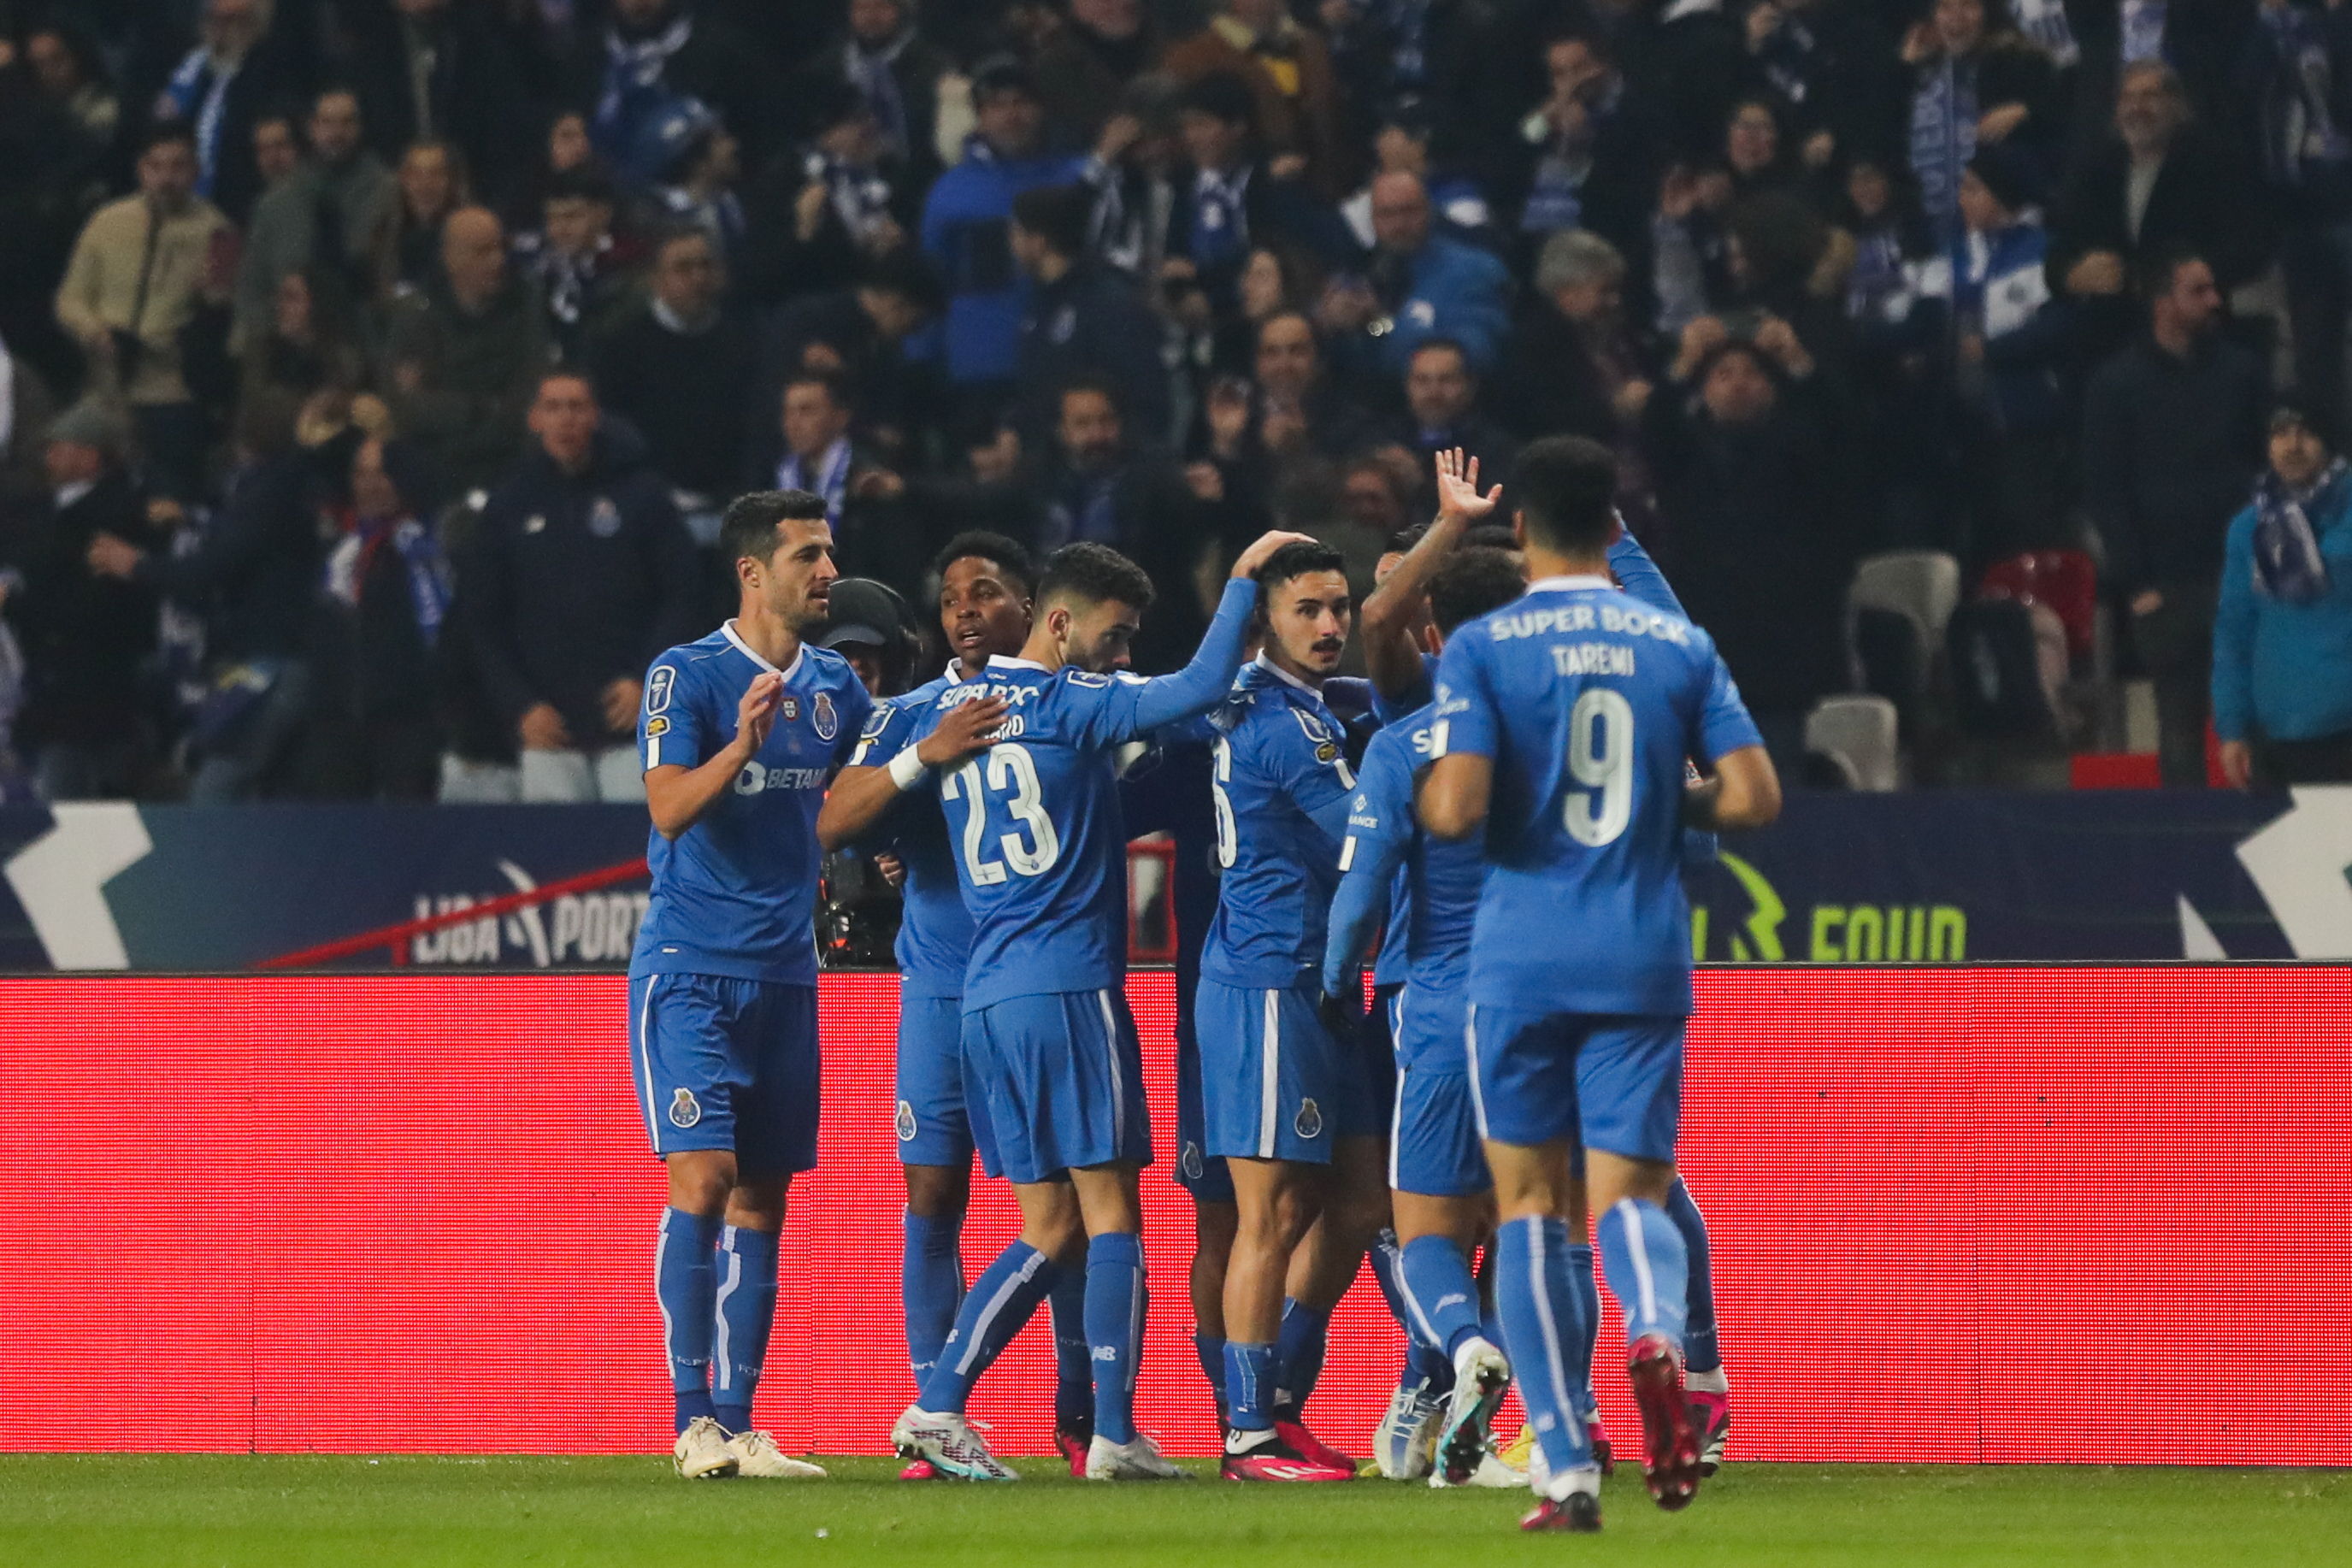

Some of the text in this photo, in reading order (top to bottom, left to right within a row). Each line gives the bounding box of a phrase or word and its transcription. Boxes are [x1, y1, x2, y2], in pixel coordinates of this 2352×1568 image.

[1490, 604, 1690, 647] SUPER BOCK
[1551, 642, 1635, 677] TAREMI
[942, 742, 1059, 887] 23
[1564, 687, 1634, 848] 9
